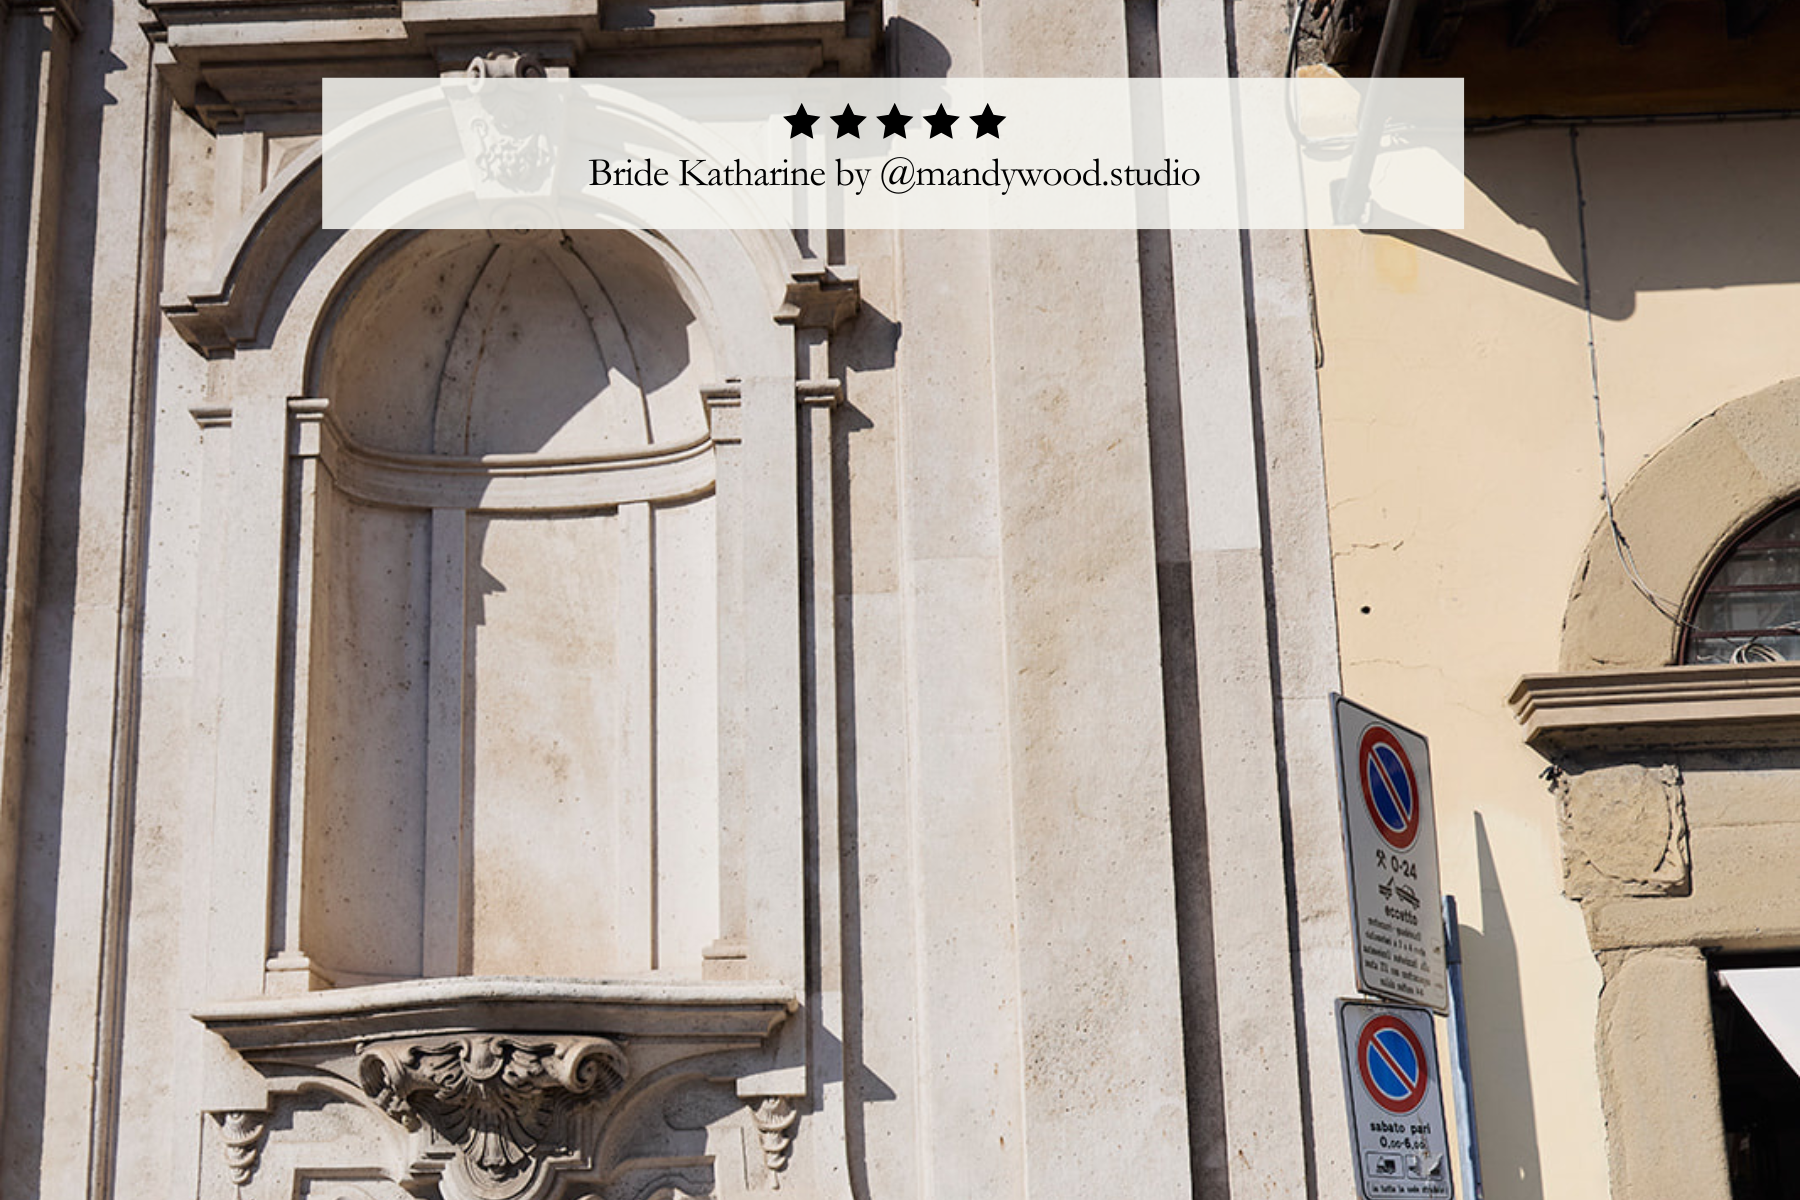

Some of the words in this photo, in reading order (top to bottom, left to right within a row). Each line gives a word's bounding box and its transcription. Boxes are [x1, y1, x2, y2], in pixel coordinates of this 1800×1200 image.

[1391, 855, 1417, 880] 0-24
[1370, 1120, 1406, 1133] sabato
[1410, 1122, 1431, 1136] pari
